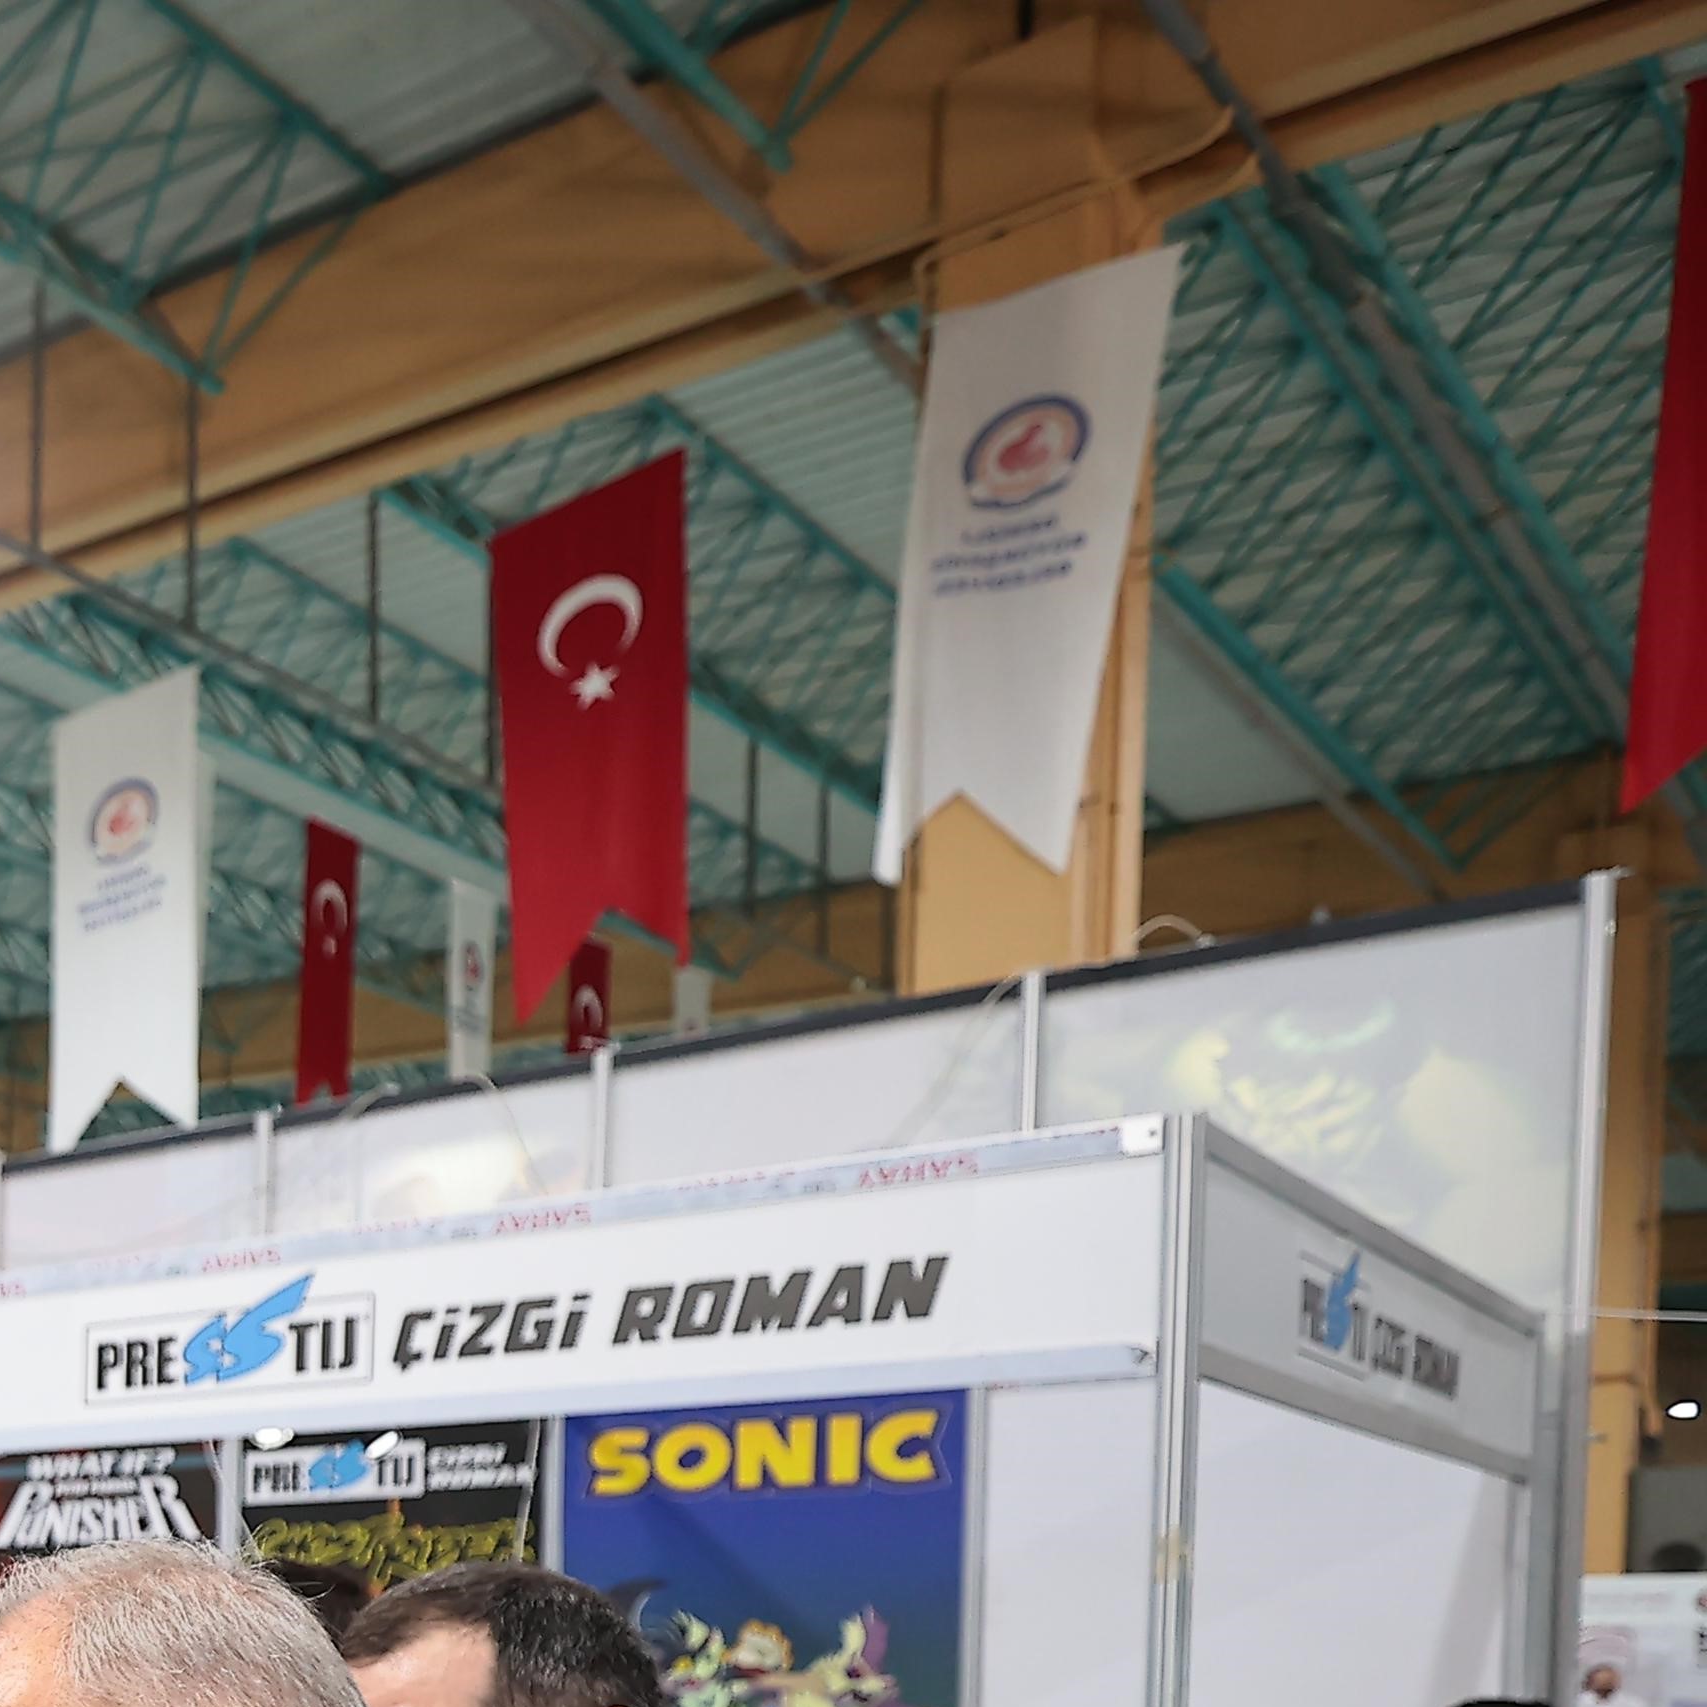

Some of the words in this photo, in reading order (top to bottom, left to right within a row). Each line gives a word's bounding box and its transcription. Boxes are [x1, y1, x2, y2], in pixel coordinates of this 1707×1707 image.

[393, 1293, 592, 1374] ÇİZGİ
[611, 1253, 951, 1346] ROMAN
[26, 1449, 117, 1480] WHAT
[588, 1409, 942, 1496] SONIC
